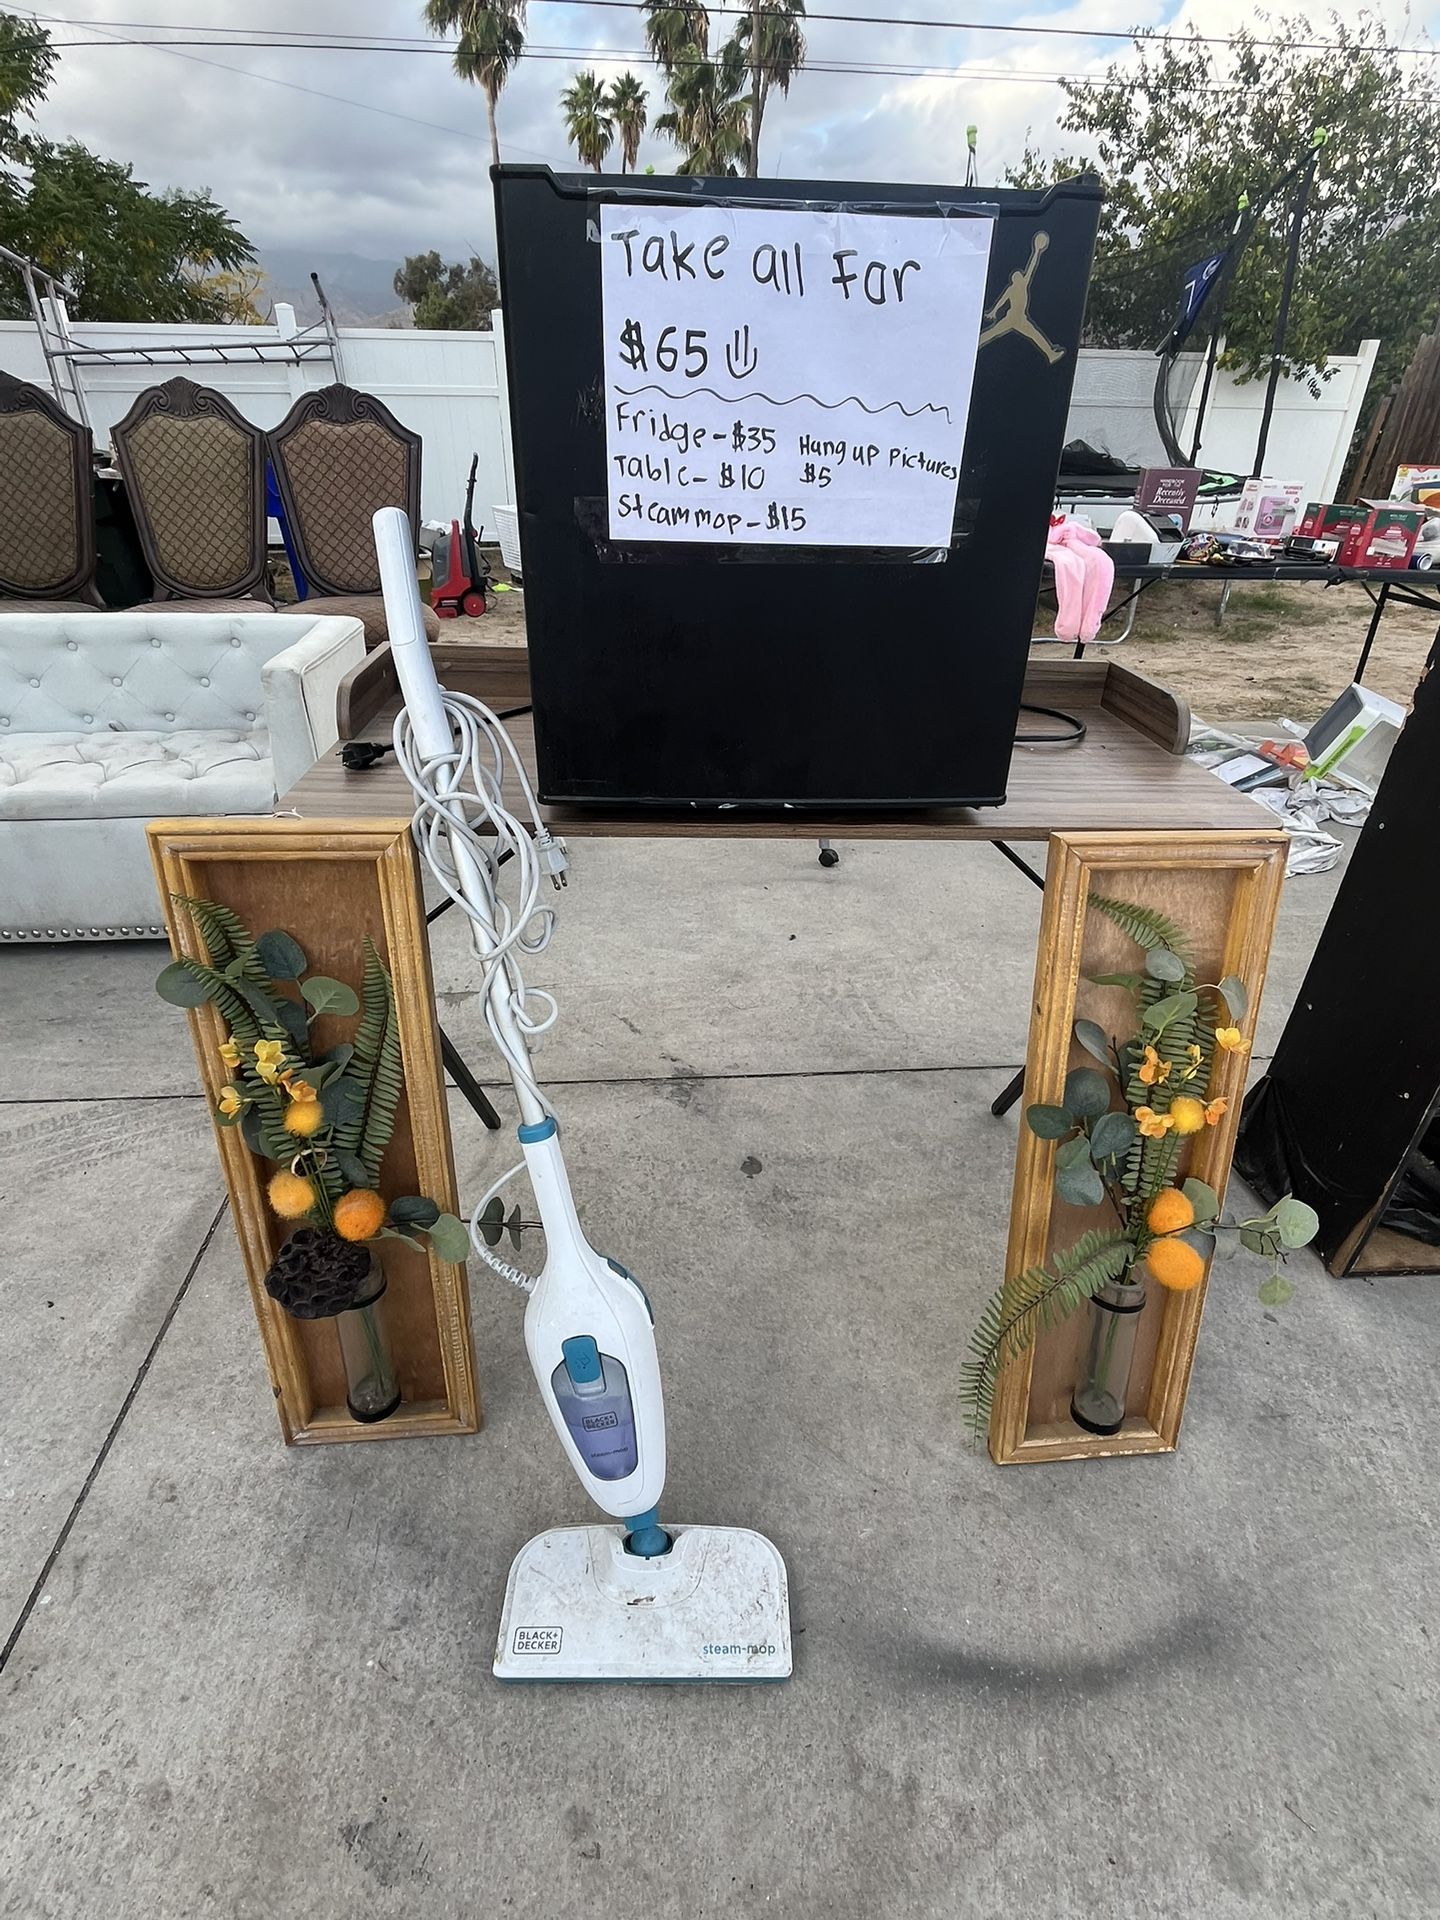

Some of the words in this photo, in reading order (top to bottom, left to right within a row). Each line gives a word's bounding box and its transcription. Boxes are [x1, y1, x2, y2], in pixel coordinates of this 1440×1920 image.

[611, 229, 730, 281] Take
[752, 242, 804, 296] all
[618, 318, 708, 378] $65
[799, 462, 832, 488] $5
[517, 1641, 557, 1650] DECKER
[519, 1631, 558, 1640] BLACK+
[702, 1642, 776, 1656] steam-mop
